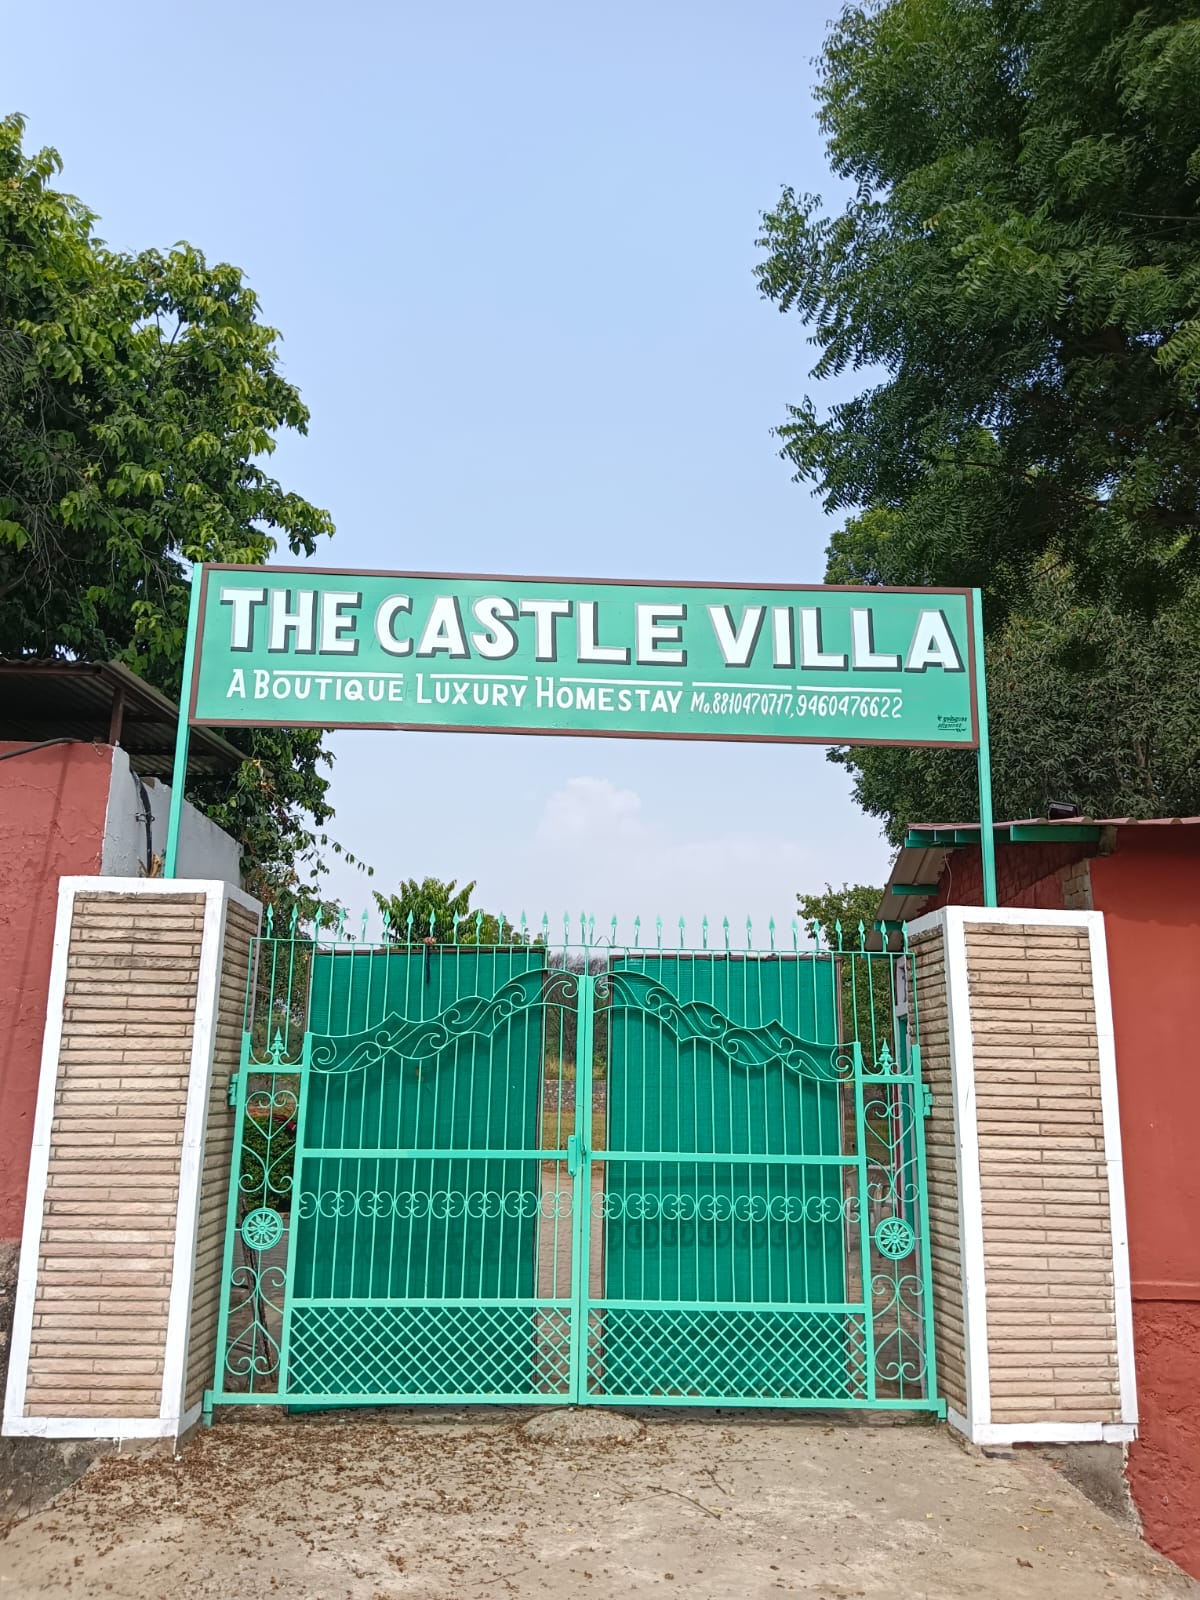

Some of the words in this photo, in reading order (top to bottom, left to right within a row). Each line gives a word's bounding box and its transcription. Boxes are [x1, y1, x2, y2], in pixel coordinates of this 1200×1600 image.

[220, 587, 362, 656] THE
[375, 593, 687, 667] CASTLE
[707, 604, 965, 673] VILLA
[226, 669, 246, 698] A
[253, 669, 403, 702] BOUTIQUE
[416, 673, 527, 706] LUXURY
[536, 676, 683, 714] HOMESTAY
